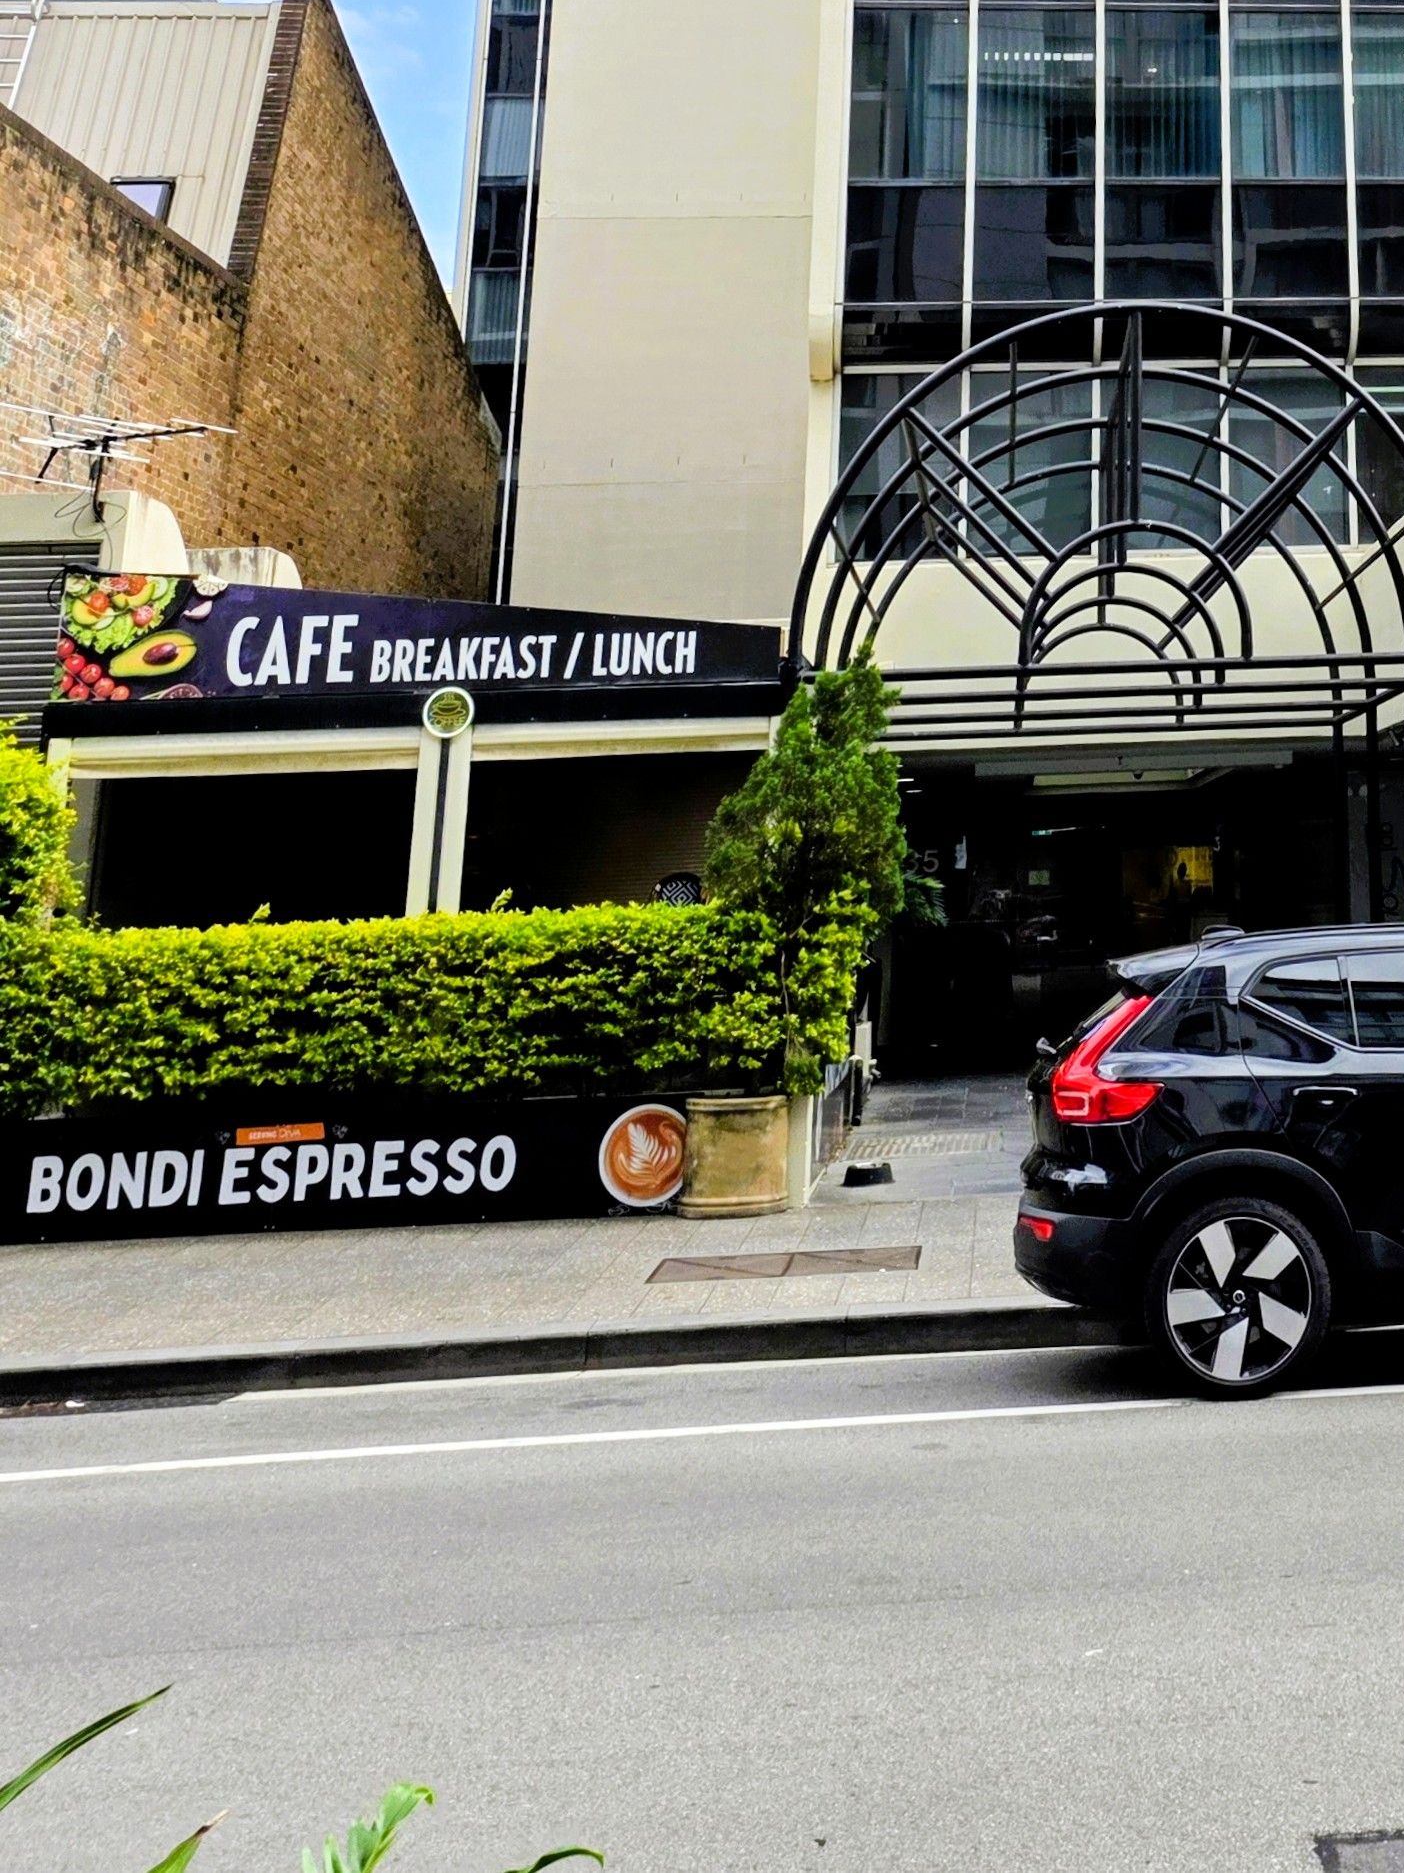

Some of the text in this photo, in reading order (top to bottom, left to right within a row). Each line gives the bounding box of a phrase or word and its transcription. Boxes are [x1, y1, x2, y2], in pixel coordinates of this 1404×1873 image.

[225, 614, 698, 687] CAFE BREAKFAST / LUNCH
[26, 1135, 518, 1214] BONDI ESPRESSO
